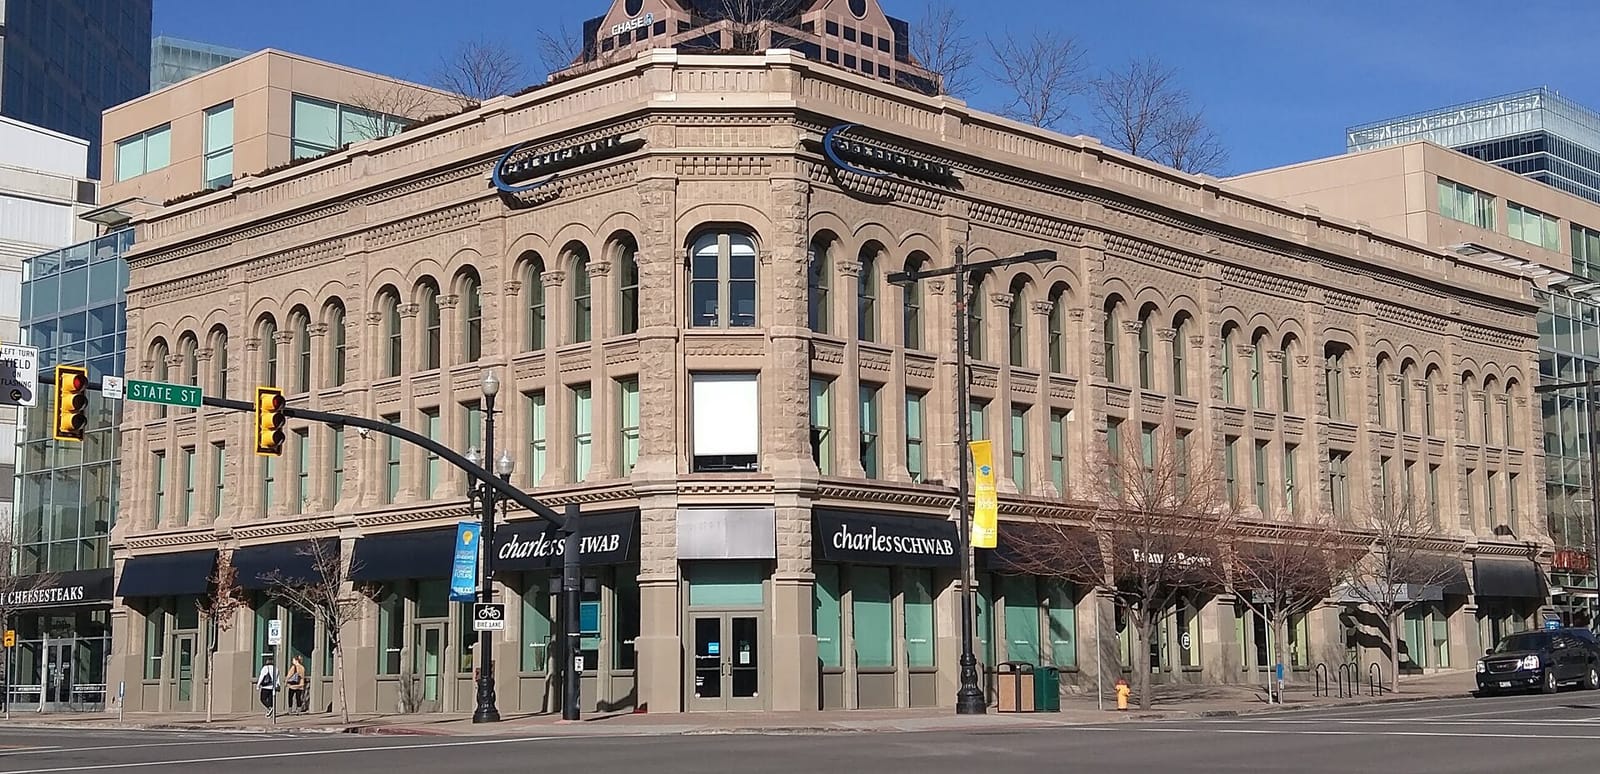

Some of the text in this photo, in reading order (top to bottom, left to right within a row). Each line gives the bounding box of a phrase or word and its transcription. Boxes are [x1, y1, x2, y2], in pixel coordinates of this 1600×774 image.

[611, 17, 644, 35] CHASE
[18, 349, 35, 357] TURN
[4, 357, 31, 370] YIELD
[133, 384, 172, 401] STATE
[181, 390, 196, 403] ST
[8, 585, 84, 605] CHEESESTEAKS
